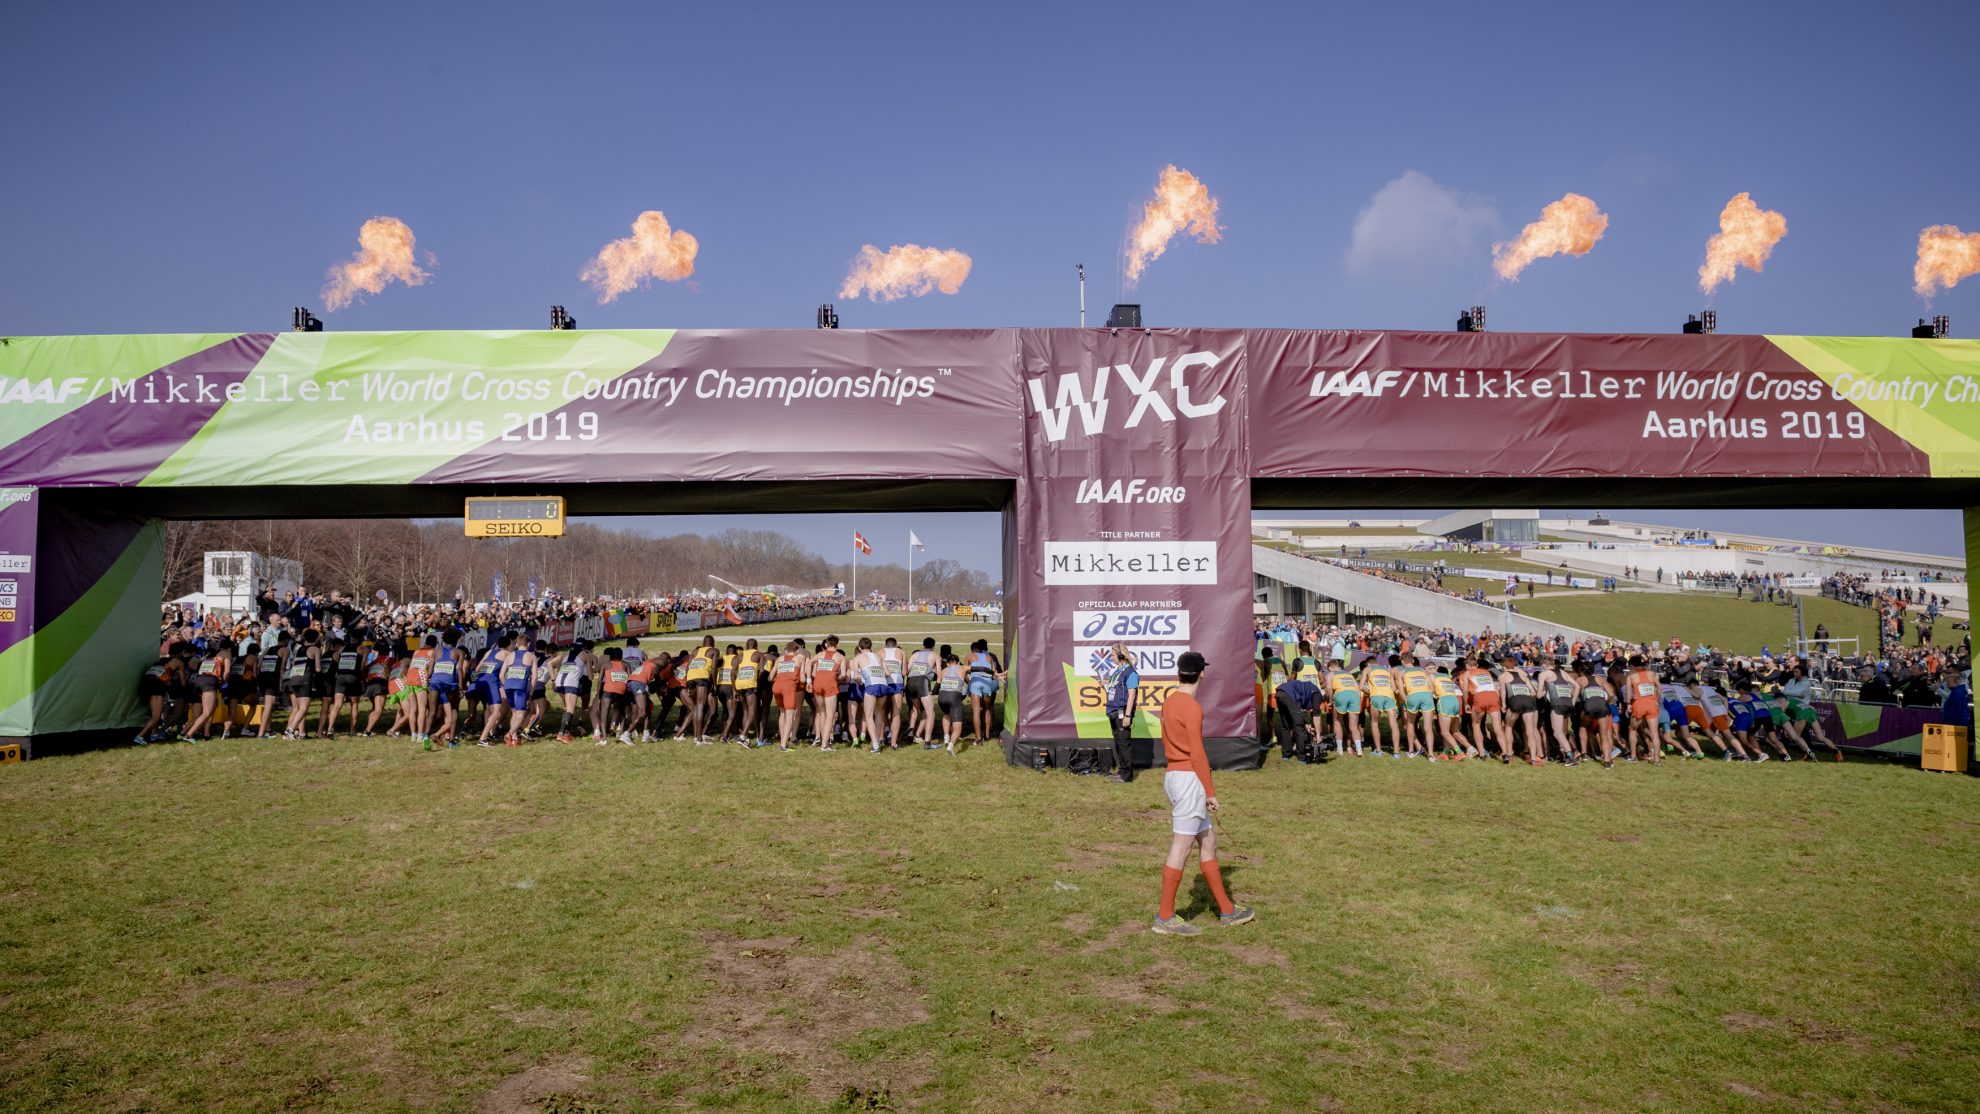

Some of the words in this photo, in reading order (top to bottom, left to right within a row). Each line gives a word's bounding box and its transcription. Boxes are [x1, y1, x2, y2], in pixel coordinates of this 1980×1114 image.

[362, 371, 453, 401] World
[462, 371, 551, 401] Cross
[562, 370, 688, 407] Country
[1028, 351, 1227, 442] WXC
[1656, 371, 1740, 400] World
[1746, 371, 1823, 400] Cross
[1831, 373, 1939, 408] Country
[343, 413, 485, 443] Aarhus
[501, 411, 598, 441] 2019
[1642, 410, 1768, 438] Aarhus
[1781, 411, 1865, 438] 2019
[485, 523, 542, 534] SEIKO
[1100, 531, 1122, 539] TITLE
[1124, 531, 1161, 539] PARTNER
[1051, 553, 1210, 573] Mikkeller
[1139, 600, 1182, 608] PARTNERS
